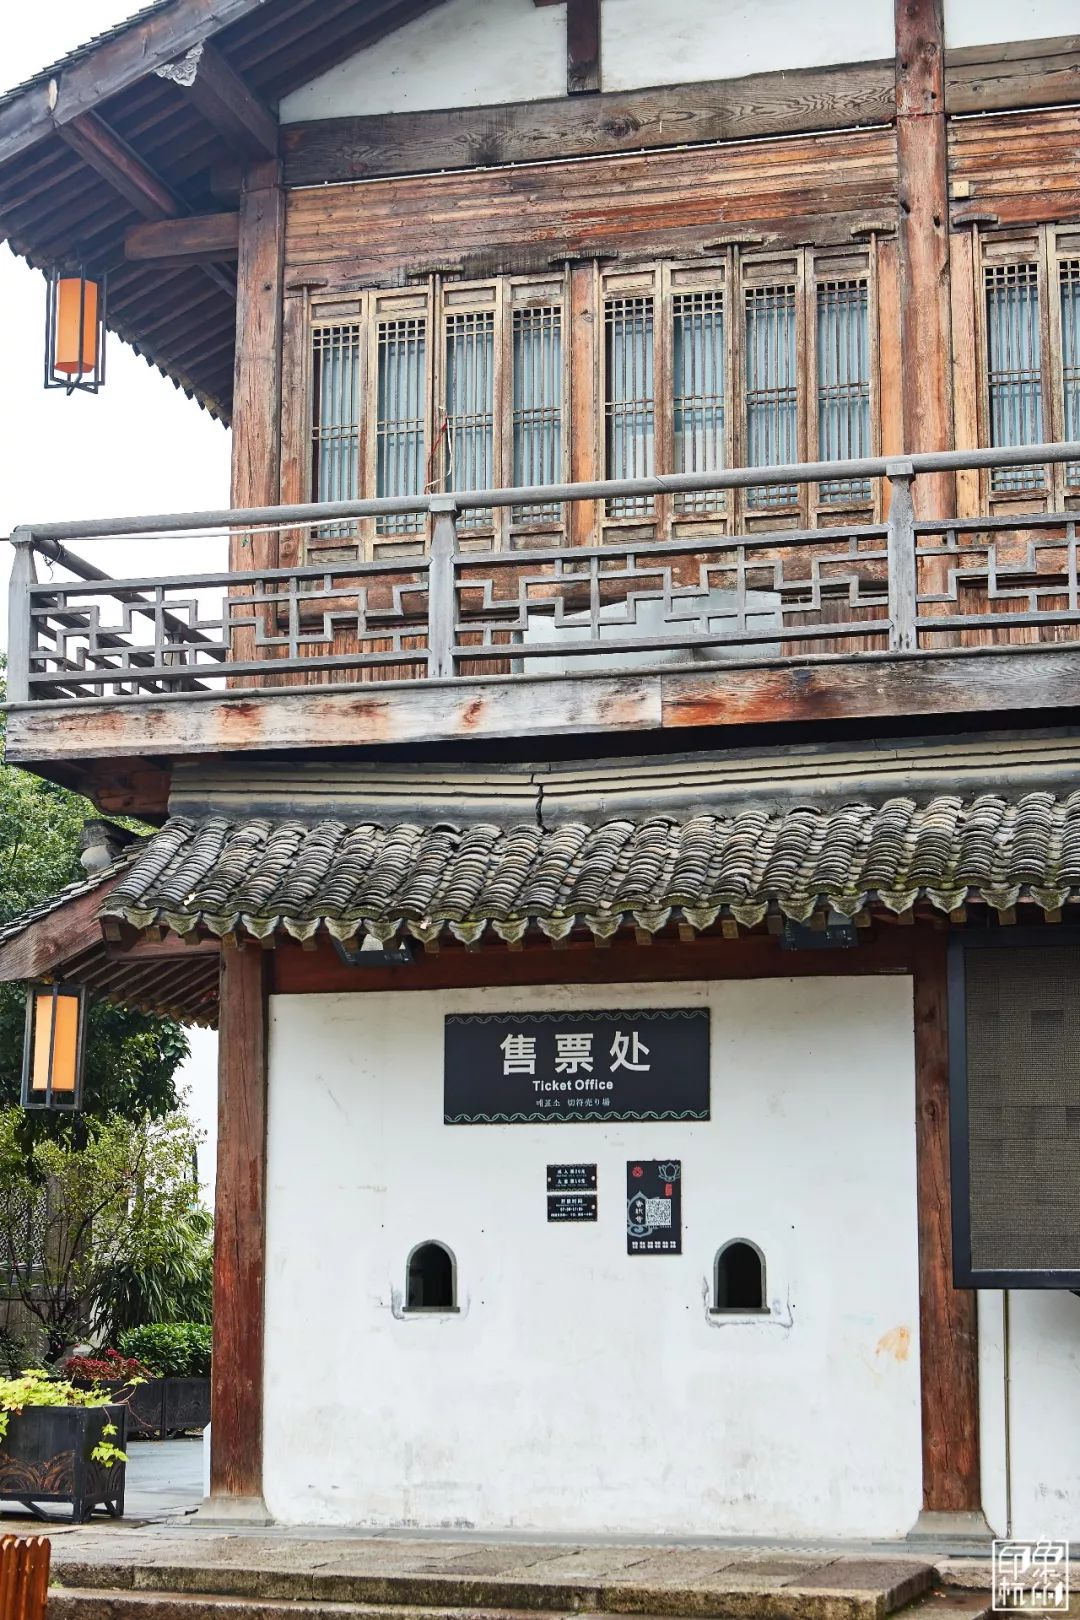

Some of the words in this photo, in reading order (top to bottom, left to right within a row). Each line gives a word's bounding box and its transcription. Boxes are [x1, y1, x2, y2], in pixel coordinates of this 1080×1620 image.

[499, 1030, 651, 1076] 售票处
[532, 1080, 572, 1092] Ticket
[574, 1078, 614, 1091] Office
[536, 1098, 561, 1108] 매표소
